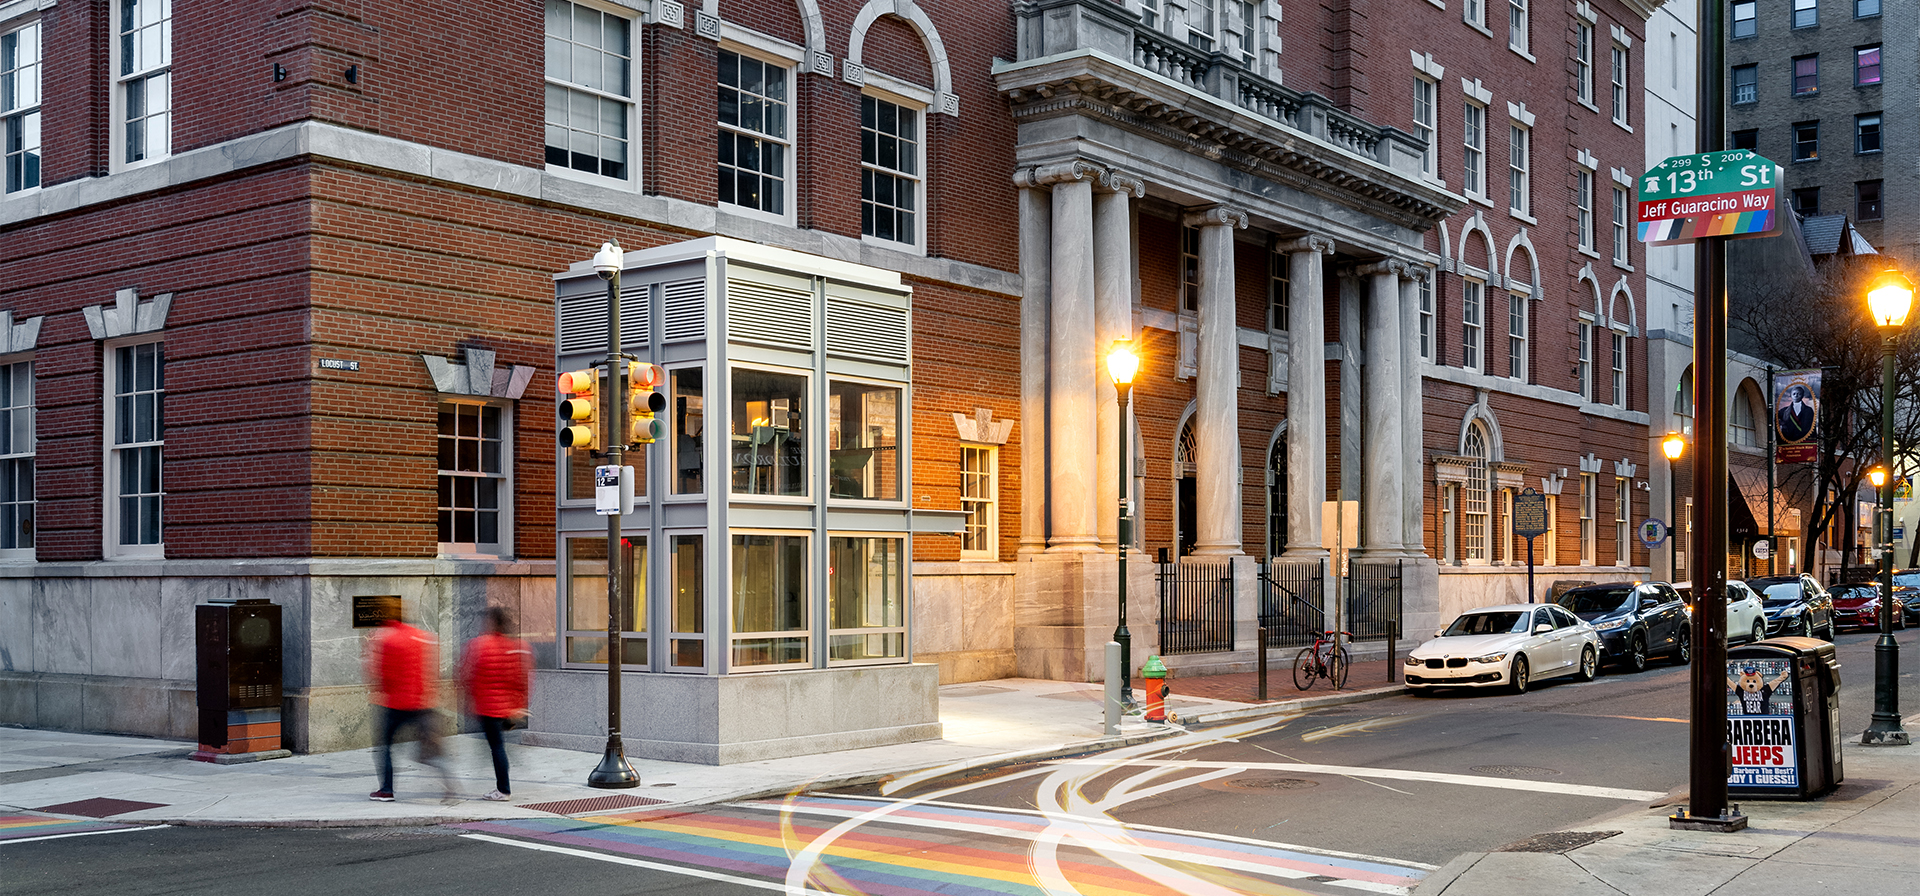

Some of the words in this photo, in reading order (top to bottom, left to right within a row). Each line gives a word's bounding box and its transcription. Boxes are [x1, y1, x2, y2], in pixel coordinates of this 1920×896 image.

[1671, 158, 1692, 168] 299
[1701, 154, 1711, 167] S
[1721, 152, 1743, 163] 200
[1666, 168, 1713, 194] 13th
[1740, 164, 1770, 187] St
[1642, 202, 1667, 218] Jeff
[1671, 196, 1738, 215] Guaracino
[1743, 193, 1770, 210] Way
[321, 359, 343, 368] LOCUST
[597, 477, 605, 487] 12
[1746, 701, 1762, 713] BEAR
[1727, 720, 1792, 745] BARBERA
[1732, 746, 1784, 765] JEEPS
[1774, 767, 1794, 775] Best?
[1727, 774, 1746, 784] BOY
[1748, 774, 1753, 784] I
[1755, 774, 1795, 784] GUESS!!
